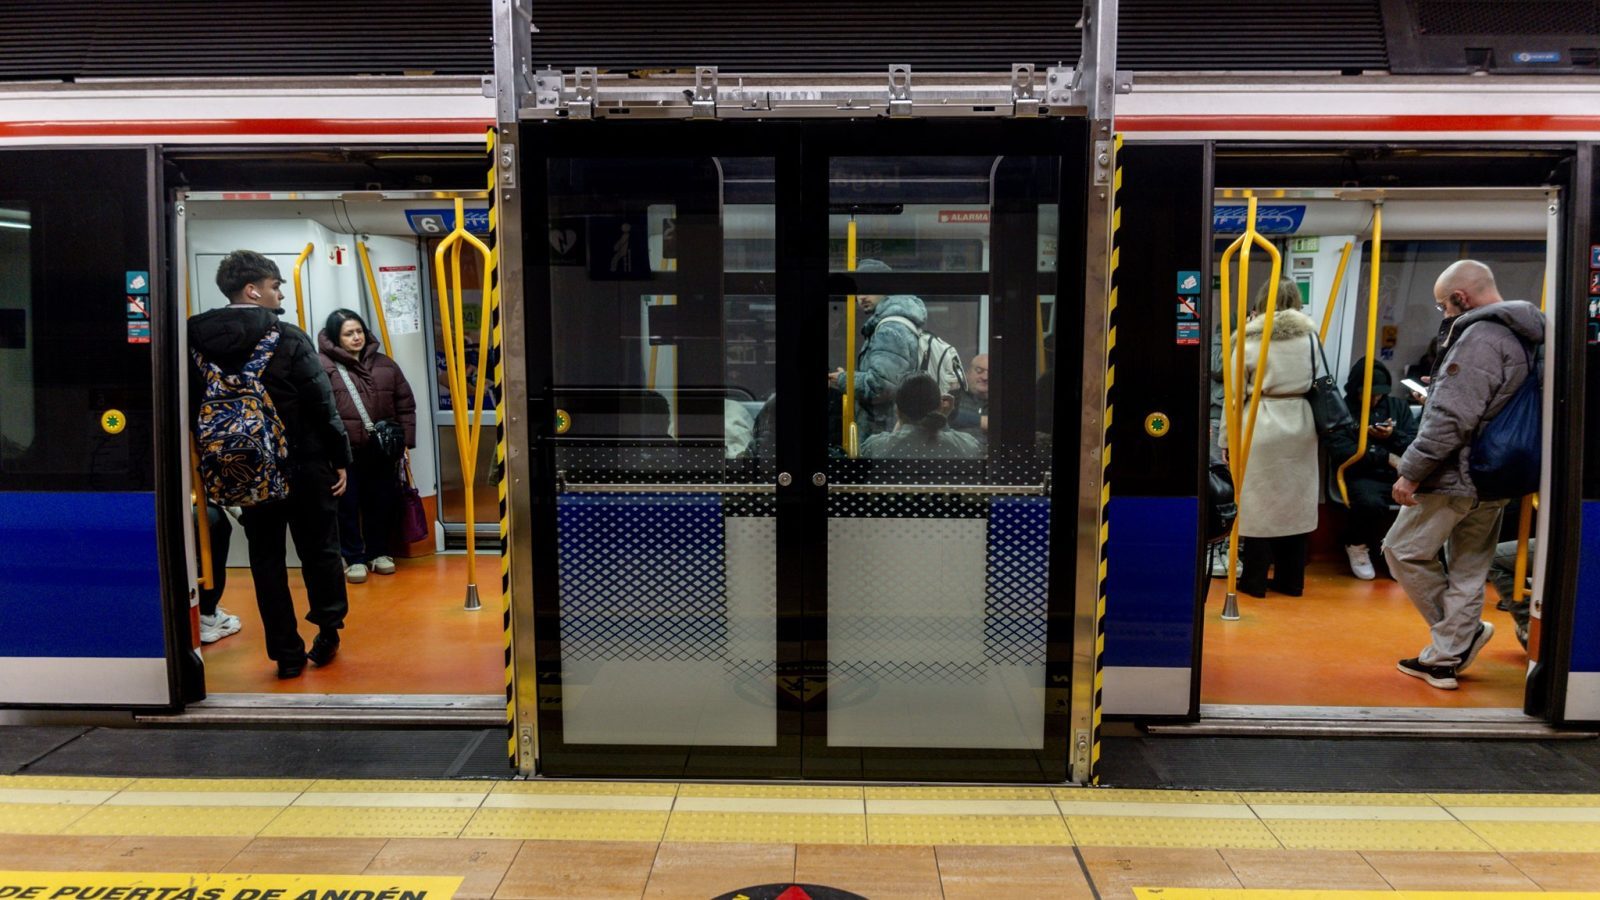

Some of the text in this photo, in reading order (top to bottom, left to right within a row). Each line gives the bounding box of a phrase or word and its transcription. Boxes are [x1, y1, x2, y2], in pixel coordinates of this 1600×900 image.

[950, 212, 989, 221] ALARMA
[421, 217, 440, 232] 6
[0, 885, 428, 900] DE PUERTAS DE ANDÉN
